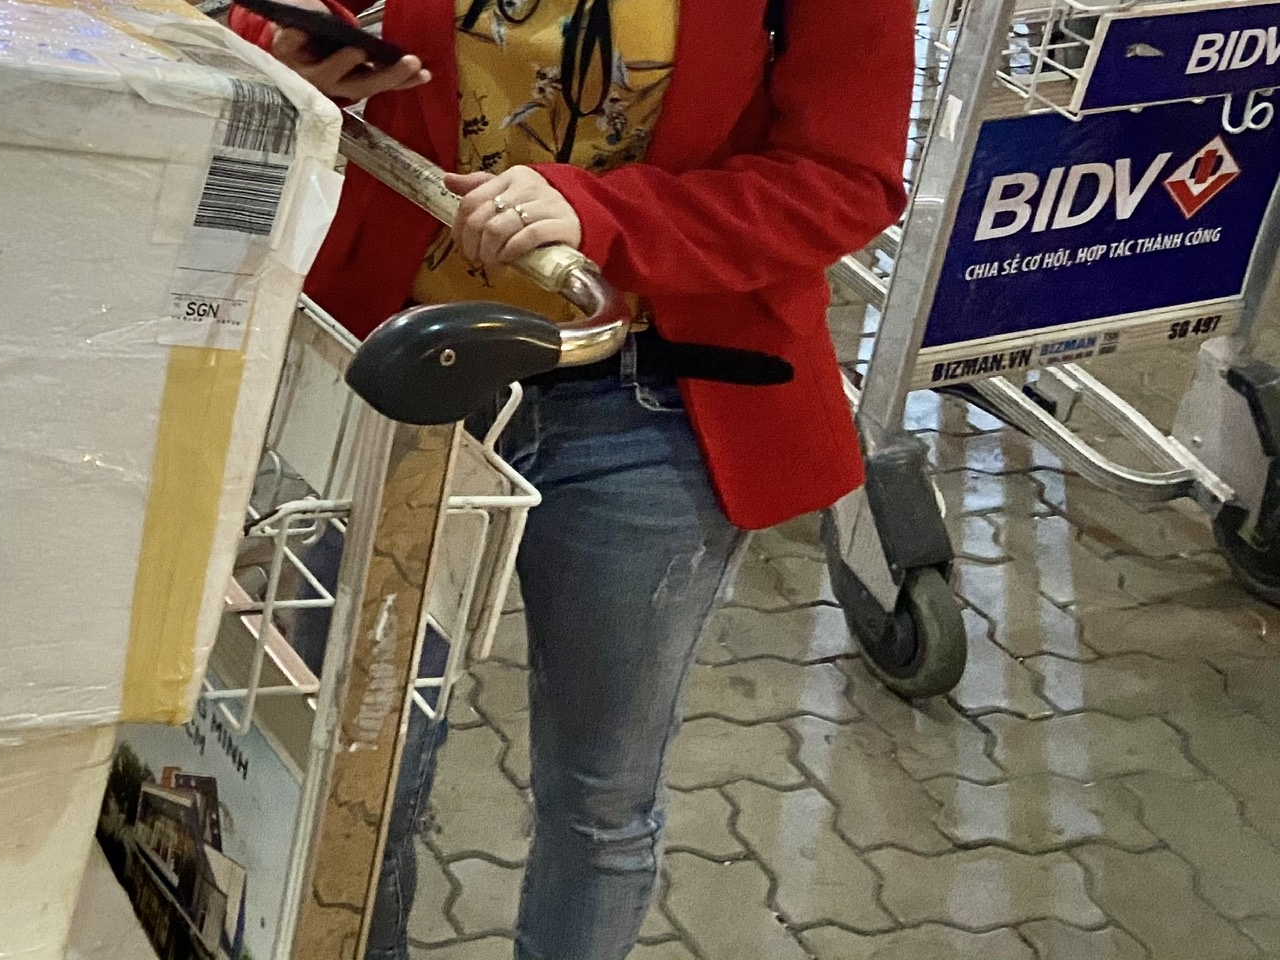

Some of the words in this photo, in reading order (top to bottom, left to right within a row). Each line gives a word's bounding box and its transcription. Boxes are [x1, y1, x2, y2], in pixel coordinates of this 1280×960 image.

[974, 150, 1173, 242] BIDV
[964, 261, 999, 282] CHIA
[1021, 252, 1043, 273] CƠ
[1043, 249, 1073, 271] HỘI,
[1075, 243, 1108, 266] HỢP
[1109, 238, 1135, 259] TÁC
[1135, 231, 1184, 254] THÀNH
[1184, 226, 1223, 246] CÔNG
[185, 301, 221, 319] SGN
[931, 348, 1032, 382] BIZMAN.VN
